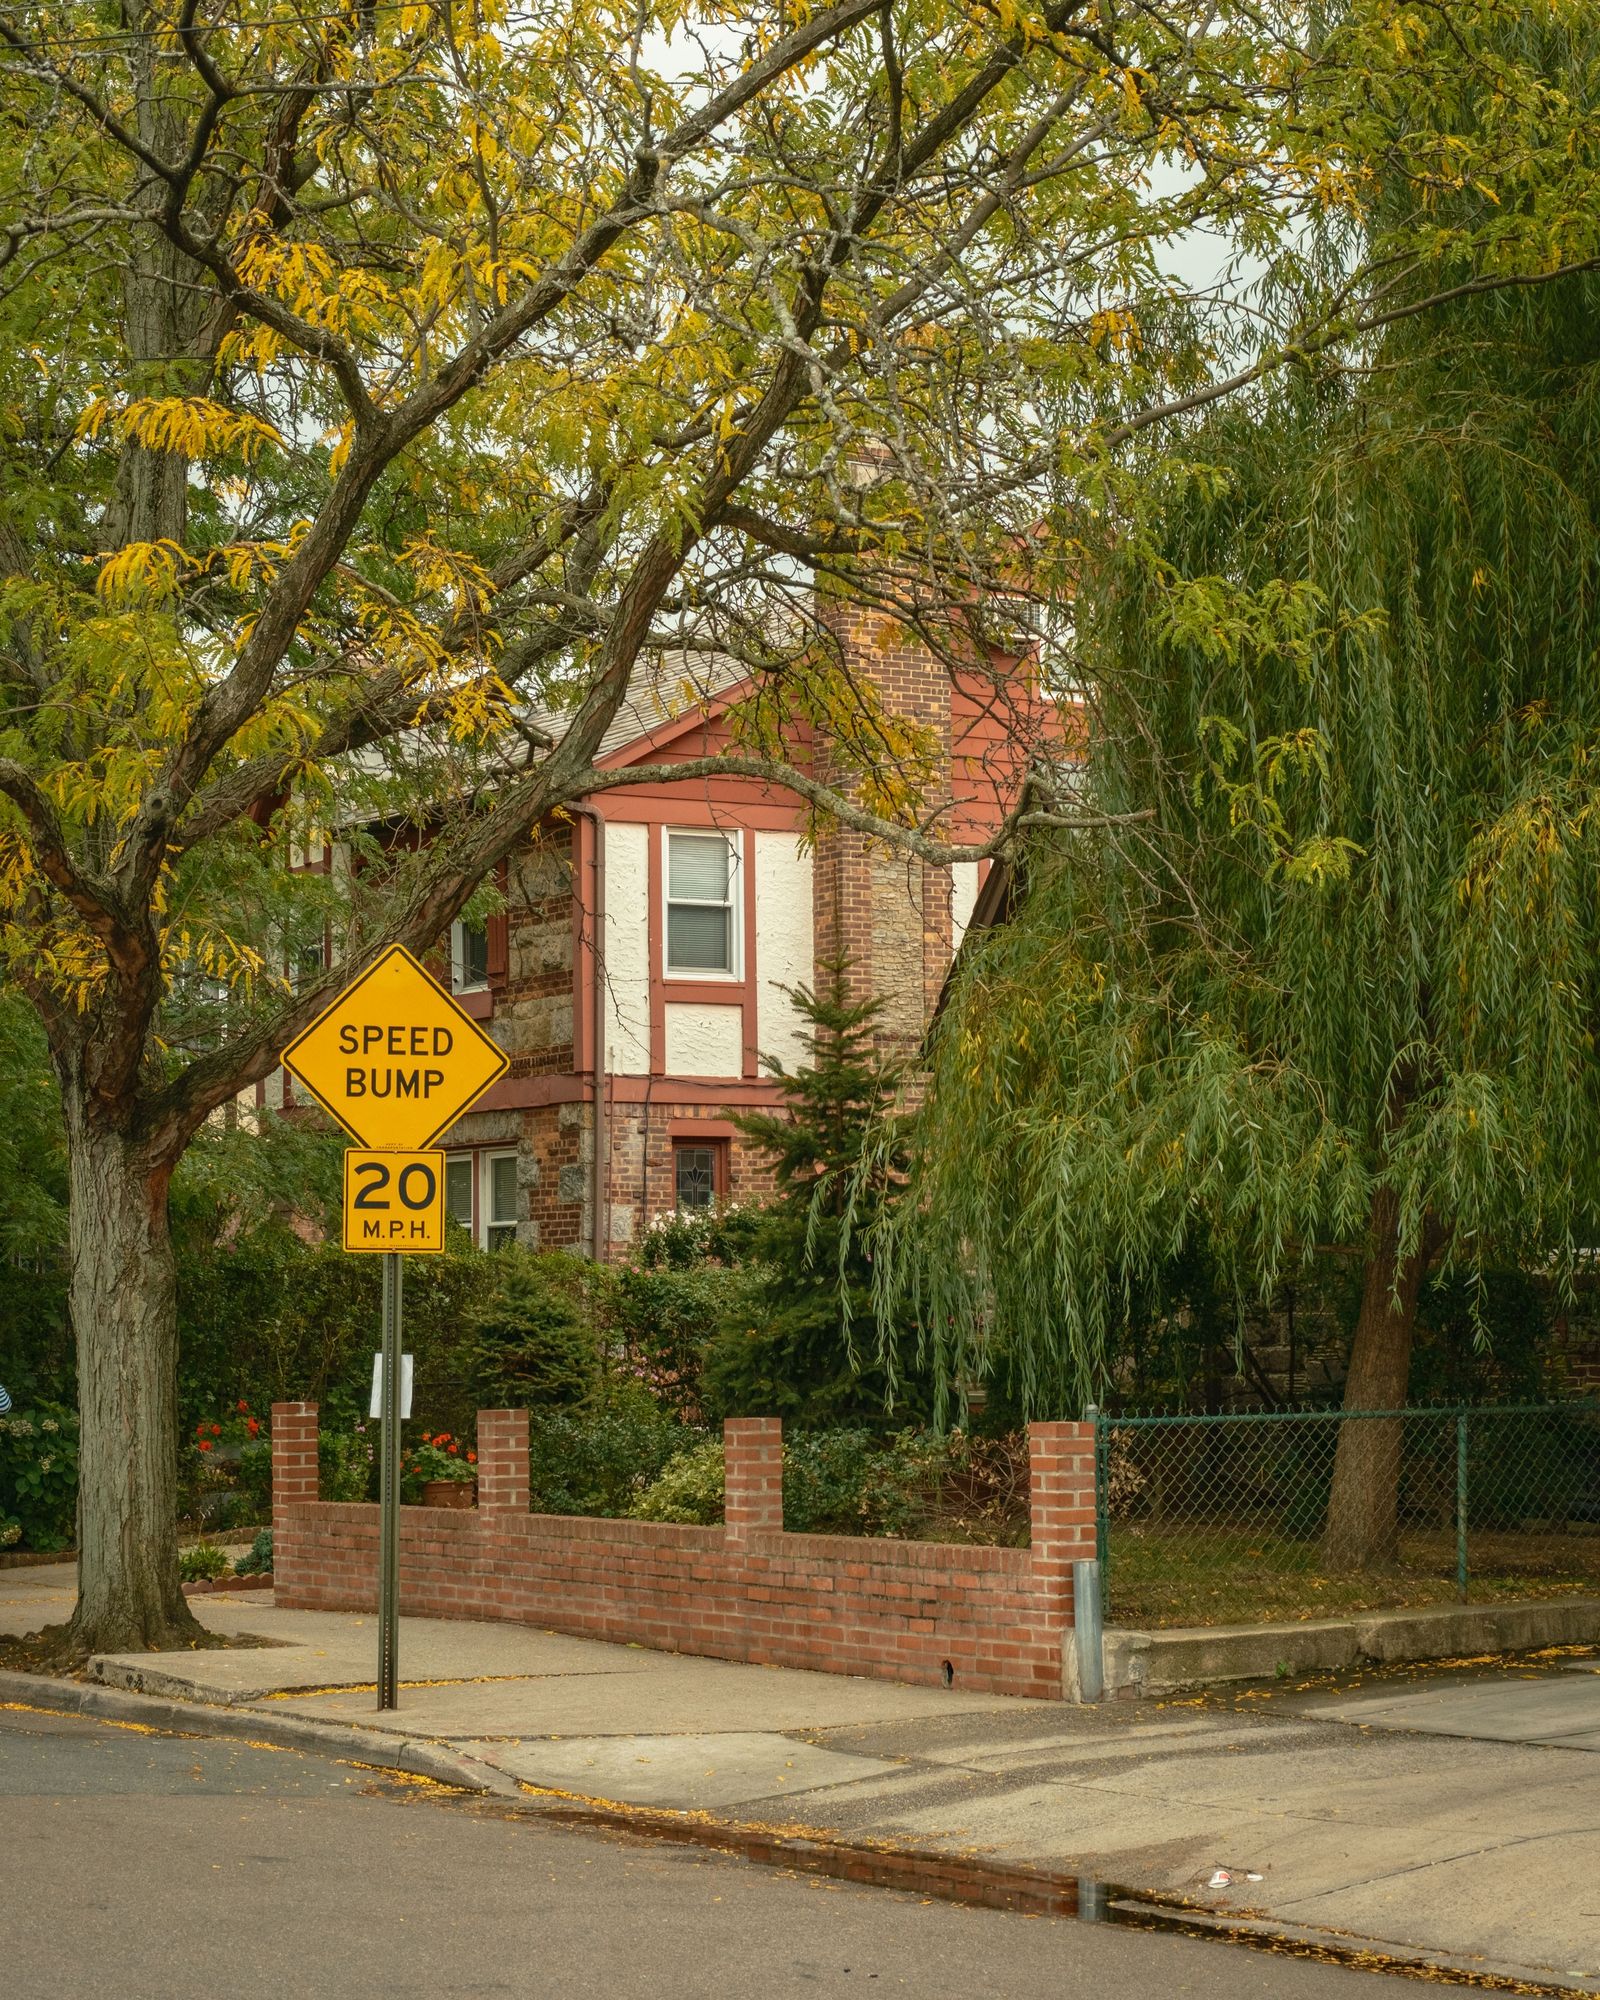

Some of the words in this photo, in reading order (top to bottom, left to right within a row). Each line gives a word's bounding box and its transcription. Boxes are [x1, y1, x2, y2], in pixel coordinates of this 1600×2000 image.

[339, 1024, 454, 1056] SPEED
[346, 1067, 445, 1099] BUMP
[353, 1162, 436, 1210] 20
[363, 1220, 430, 1239] M.P.H.
